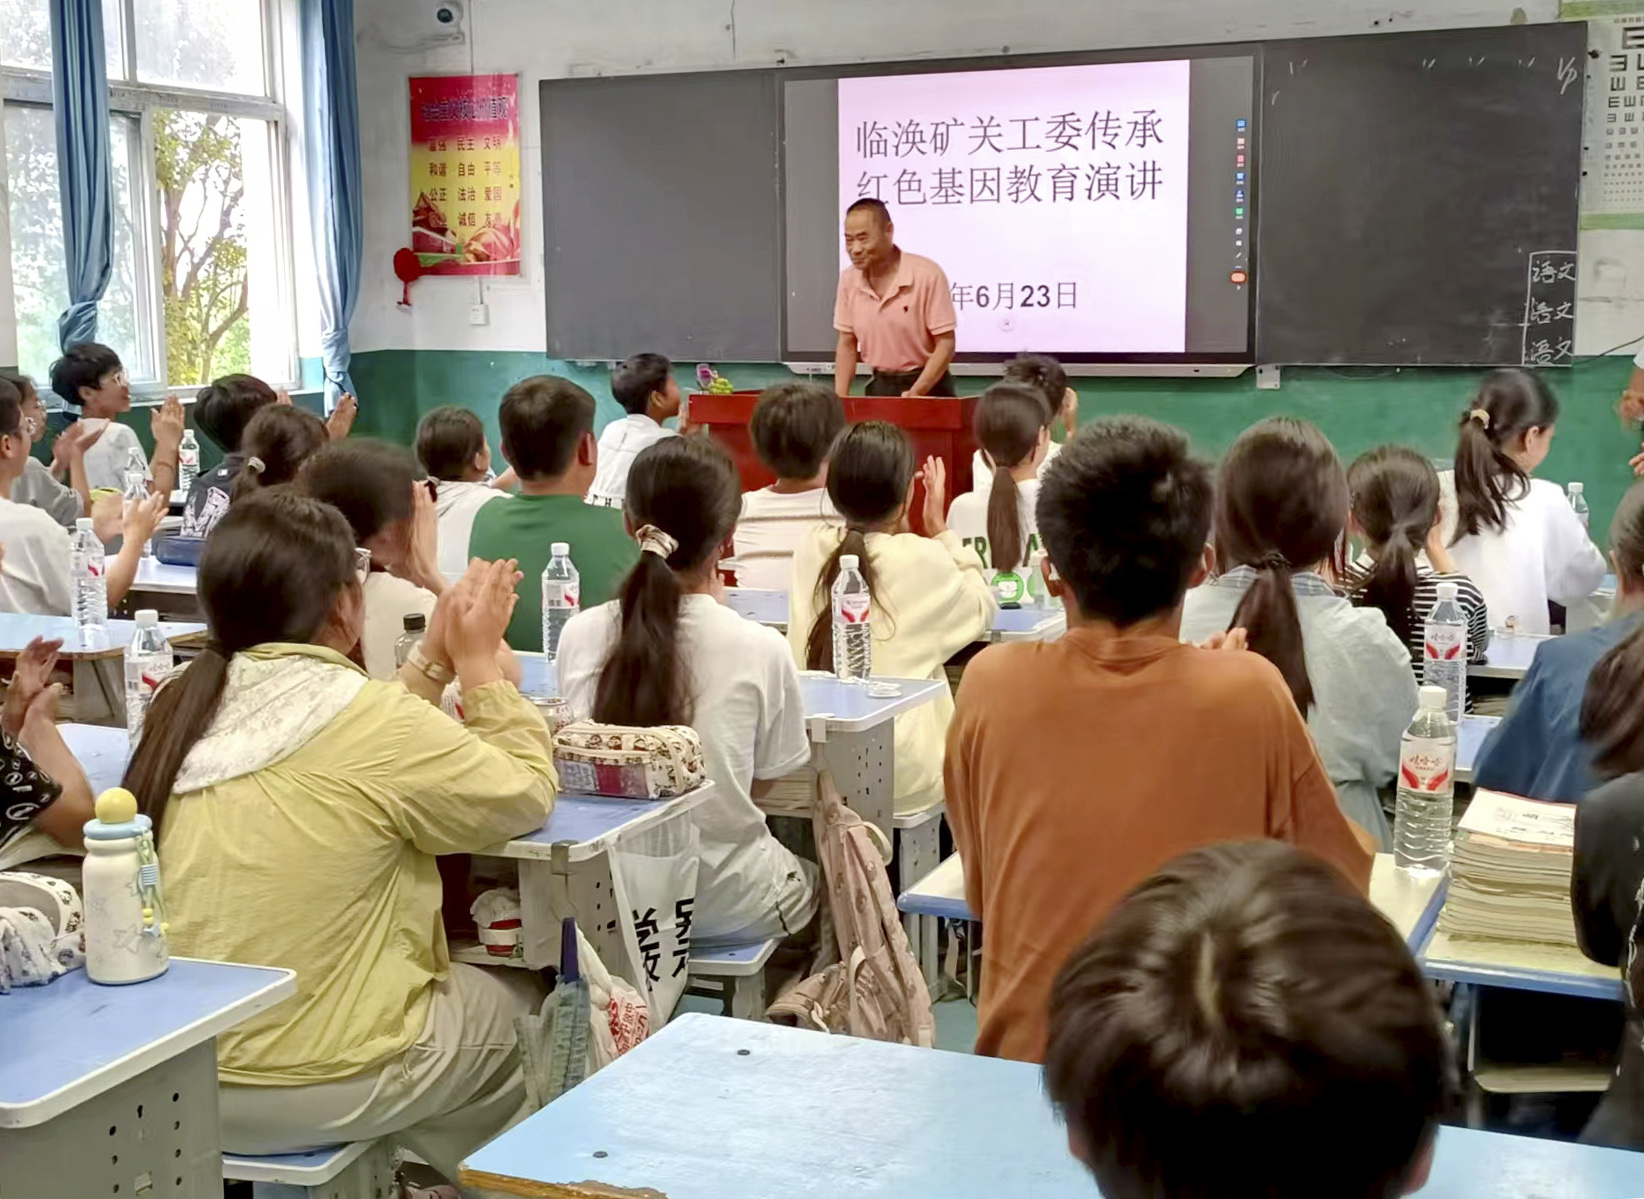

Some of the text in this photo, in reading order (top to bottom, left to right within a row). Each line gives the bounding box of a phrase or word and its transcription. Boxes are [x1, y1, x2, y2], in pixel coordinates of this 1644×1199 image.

[857, 109, 1163, 158] 临涣矿关工委传承
[458, 162, 475, 177] 自由
[857, 160, 1163, 205] 红色基因教育演讲
[429, 187, 447, 202] 公正
[1532, 260, 1577, 284] 语文
[951, 282, 1076, 311] 年6月23日
[1530, 296, 1574, 324] 语文
[1529, 336, 1573, 365] 语文
